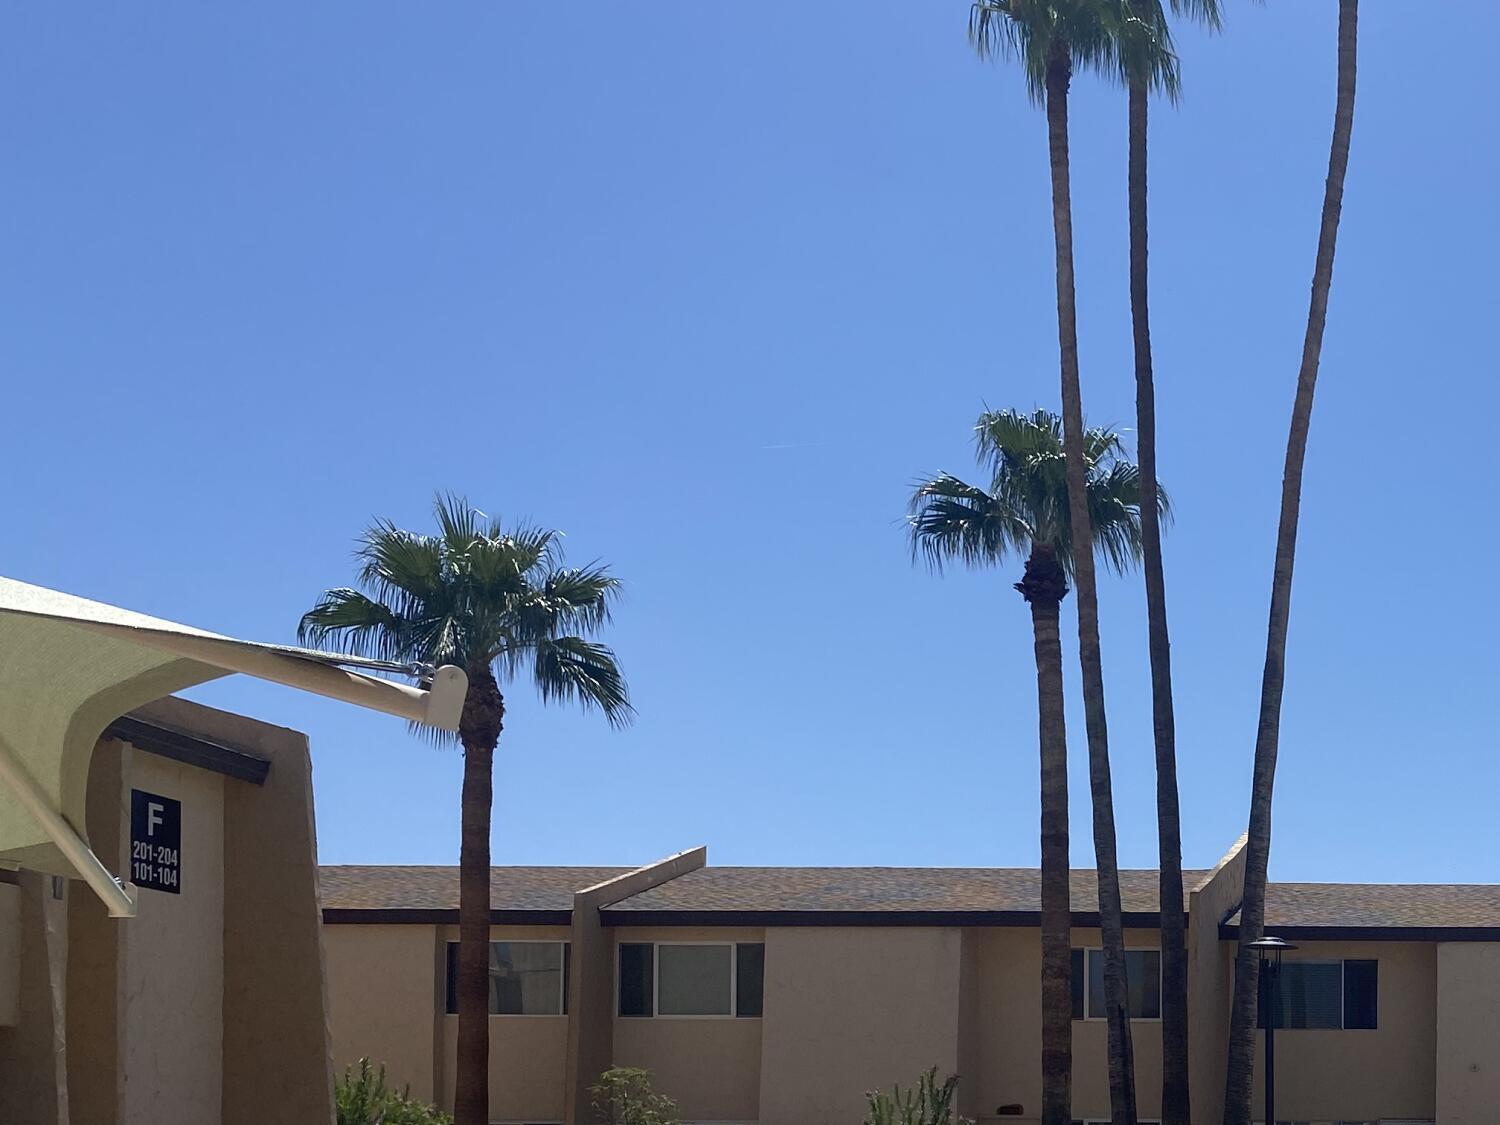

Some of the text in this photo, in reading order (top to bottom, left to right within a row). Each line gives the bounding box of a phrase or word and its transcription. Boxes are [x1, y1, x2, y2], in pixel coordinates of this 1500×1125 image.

[148, 802, 164, 836] F
[133, 841, 178, 867] 201-204
[134, 862, 178, 887] 101-104
